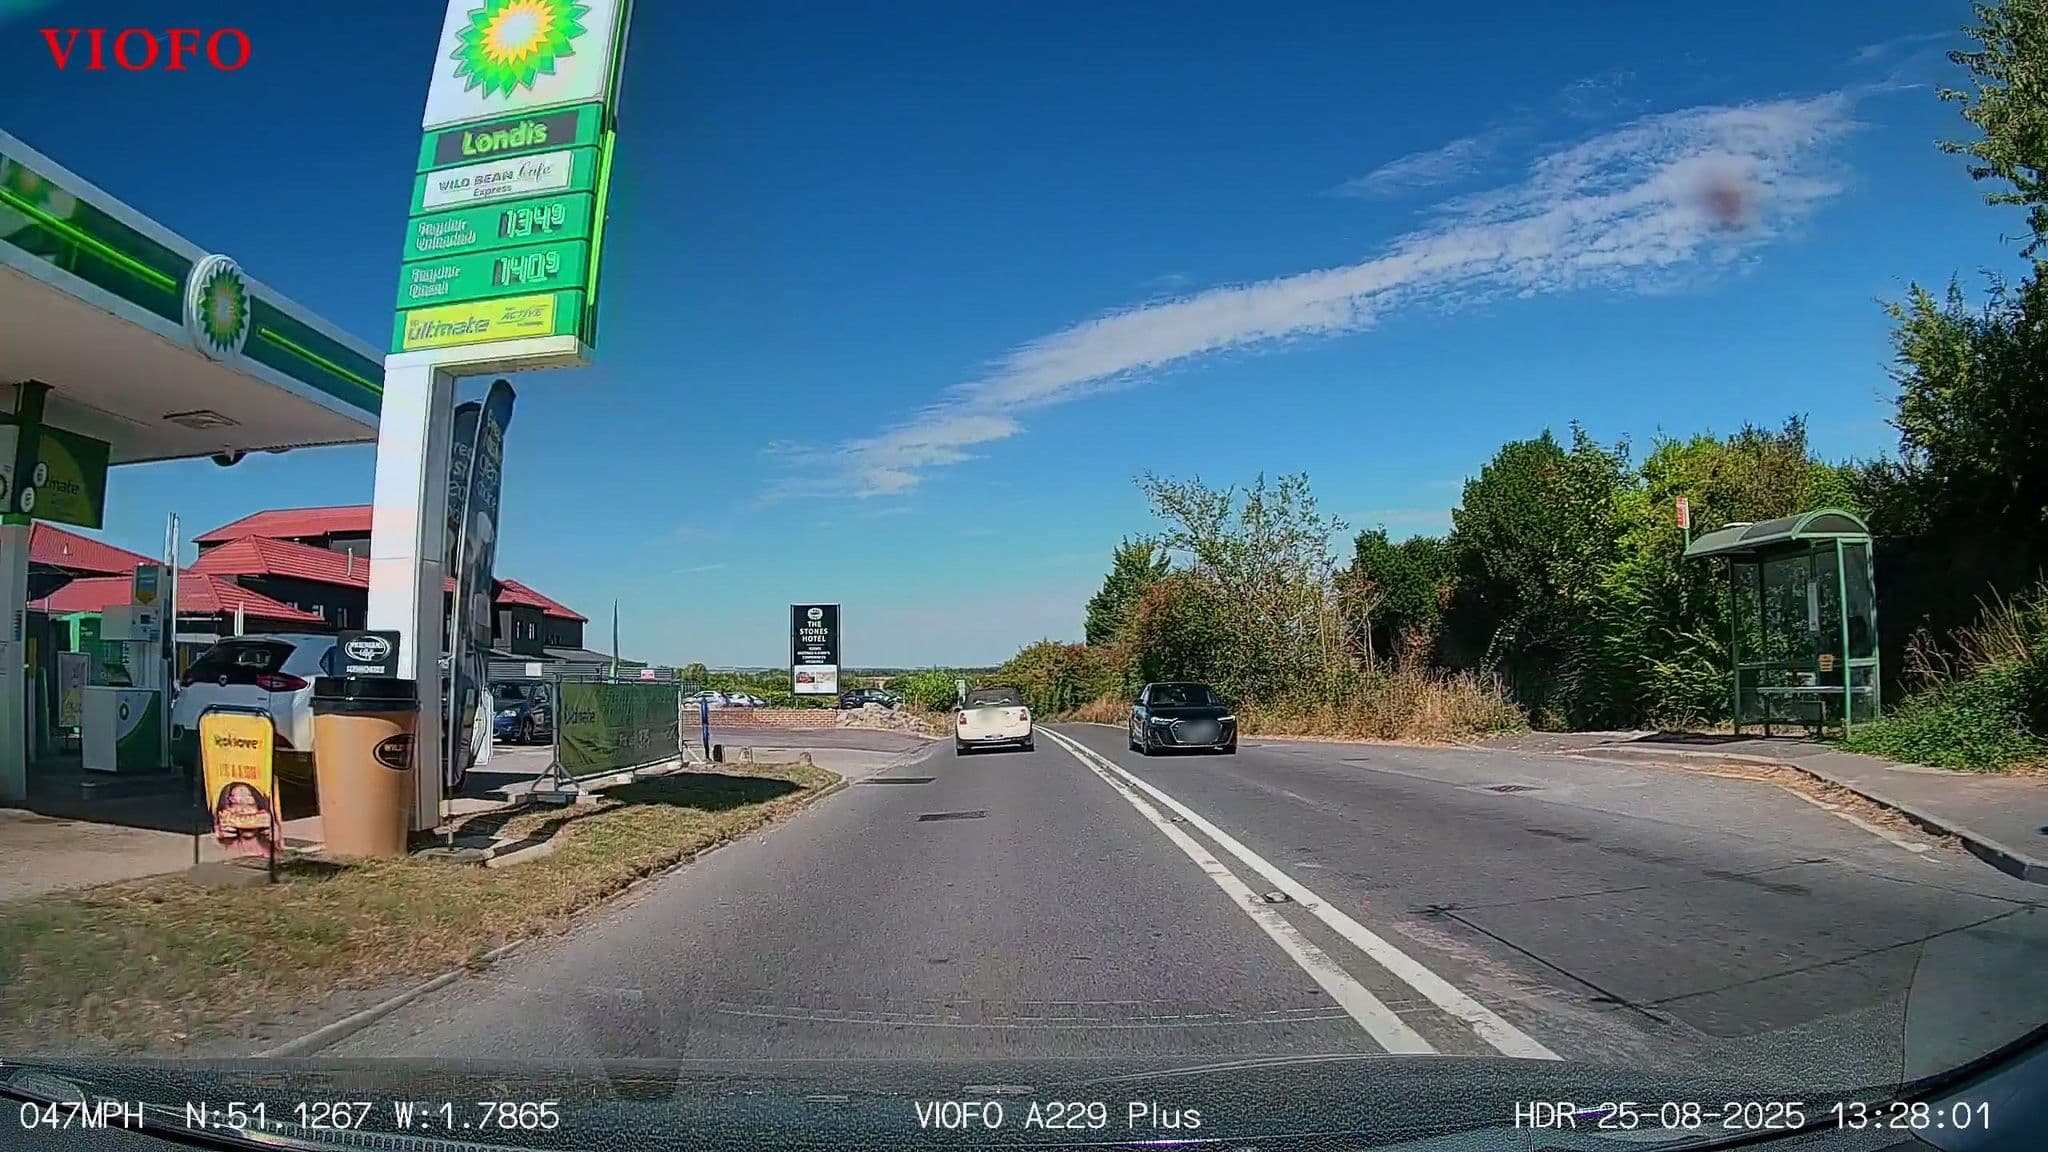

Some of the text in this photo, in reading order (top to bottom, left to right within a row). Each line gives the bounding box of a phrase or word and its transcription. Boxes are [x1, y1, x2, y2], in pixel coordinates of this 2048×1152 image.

[462, 121, 548, 156] Londis
[439, 178, 470, 191] WILD
[474, 170, 514, 186] BEAN
[473, 185, 512, 199] Express
